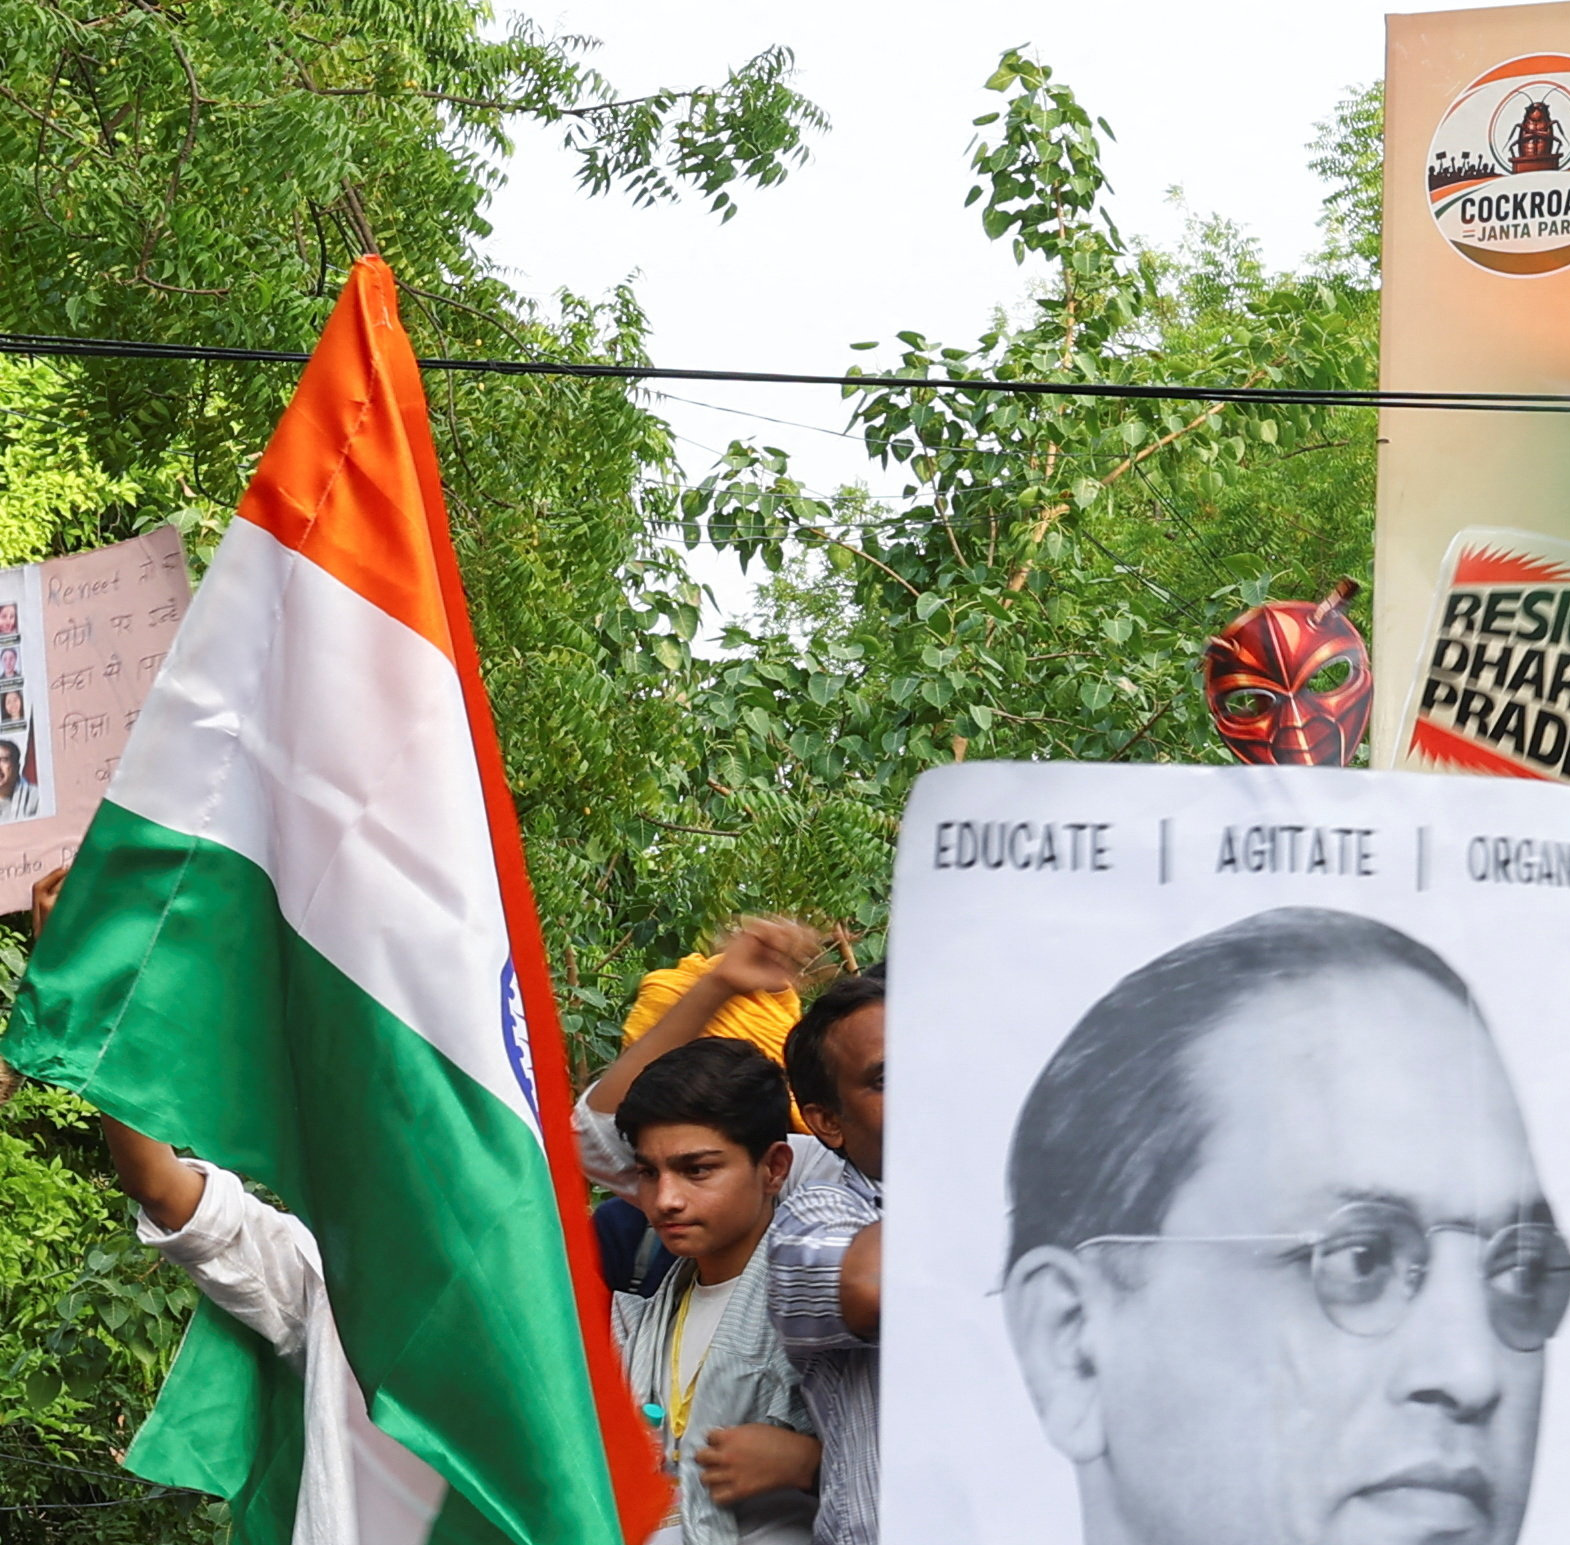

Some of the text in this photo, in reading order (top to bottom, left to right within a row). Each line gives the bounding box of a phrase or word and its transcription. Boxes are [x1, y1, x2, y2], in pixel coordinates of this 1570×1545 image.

[1478, 223, 1531, 242] JANTA
[935, 820, 1115, 873] EDUCATE
[1215, 824, 1377, 878] AGITATE
